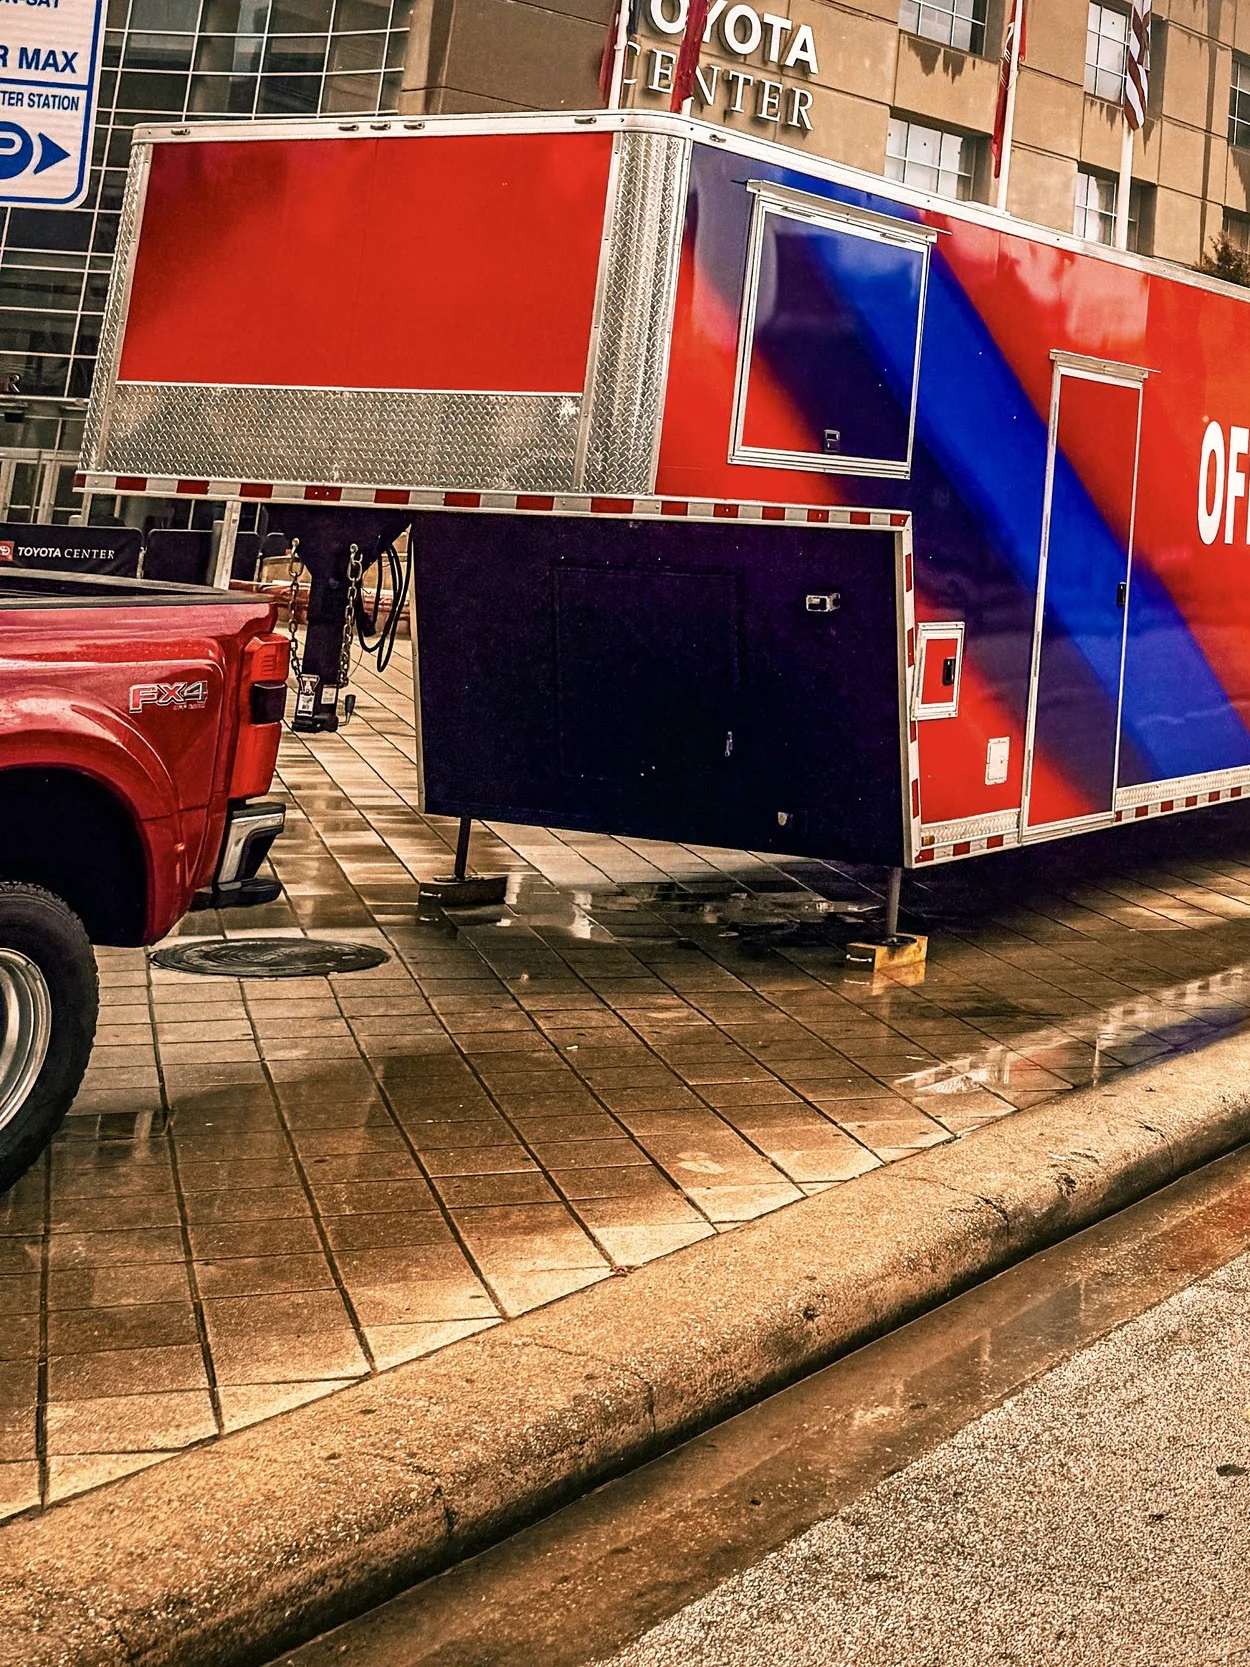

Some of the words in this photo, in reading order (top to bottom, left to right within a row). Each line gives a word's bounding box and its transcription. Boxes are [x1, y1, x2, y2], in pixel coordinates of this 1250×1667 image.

[18, 47, 79, 73] MAX
[0, 90, 24, 107] TER
[27, 92, 80, 111] STATION
[18, 546, 62, 558] TOYOTA
[64, 548, 116, 560] CENTER
[129, 680, 209, 714] FX4
